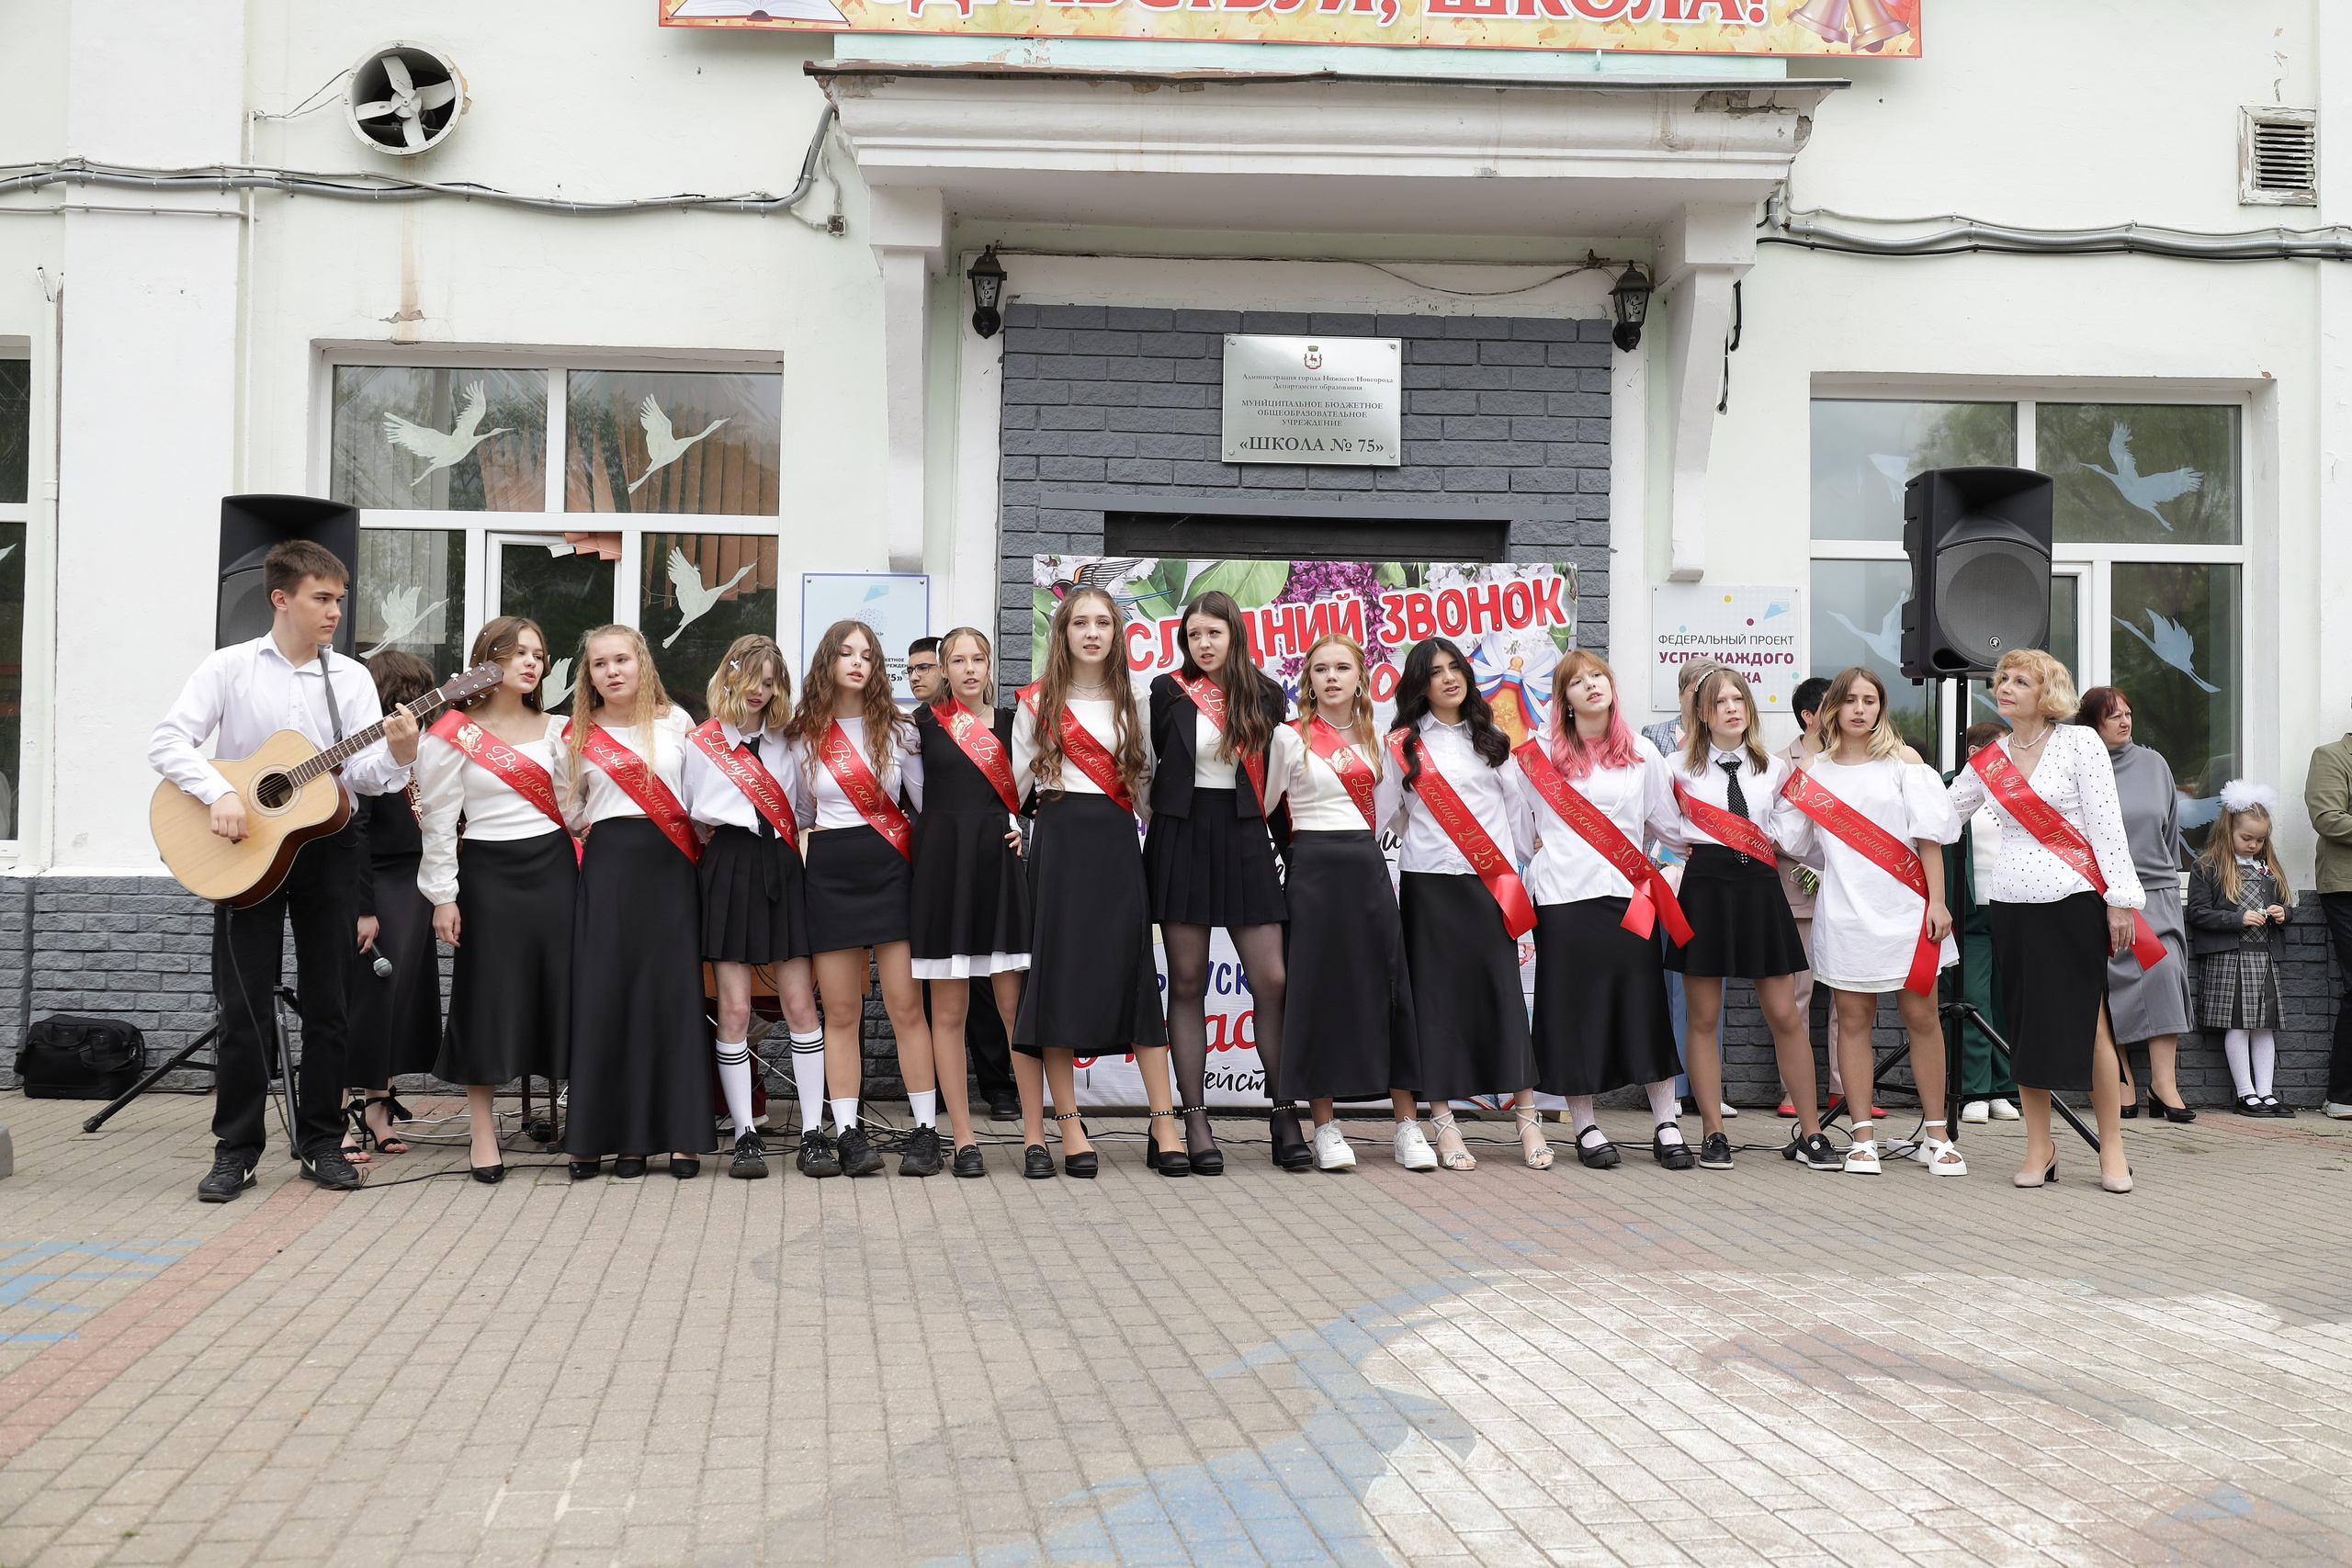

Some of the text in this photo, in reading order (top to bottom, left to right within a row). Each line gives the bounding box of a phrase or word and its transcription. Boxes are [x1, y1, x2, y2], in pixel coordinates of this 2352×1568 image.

[1242, 373, 1297, 383] Администрация
[1356, 376, 1394, 384] Новгорода
[1272, 382, 1363, 391] Департамент образования
[1241, 400, 1384, 410] МУНИЦИПАЛЬНОЕ БЮДЖЕТНОЕ
[1257, 410, 1367, 419] ОБЩЕОБРАЗОВАТЕЛЬНОЕ
[1282, 419, 1343, 427] УЧРЕЖДЕНИЕ
[1239, 436, 1385, 453] «ШКОЛА № 75»
[1380, 577, 1567, 644] ЗВОНОК
[1658, 634, 1794, 646] ФЕДЕРАЛЬНЫЙ ПРОЕКТ
[1713, 652, 1794, 667] КАЖДОГО
[485, 745, 559, 815] Выпускниц
[704, 730, 780, 814] Выпускница
[1539, 771, 1613, 847] Выпускница
[1999, 775, 2053, 829] Классный
[1696, 807, 1776, 859] Выпускница
[1807, 792, 1894, 861] Выпускница
[1457, 823, 1503, 871] 2025
